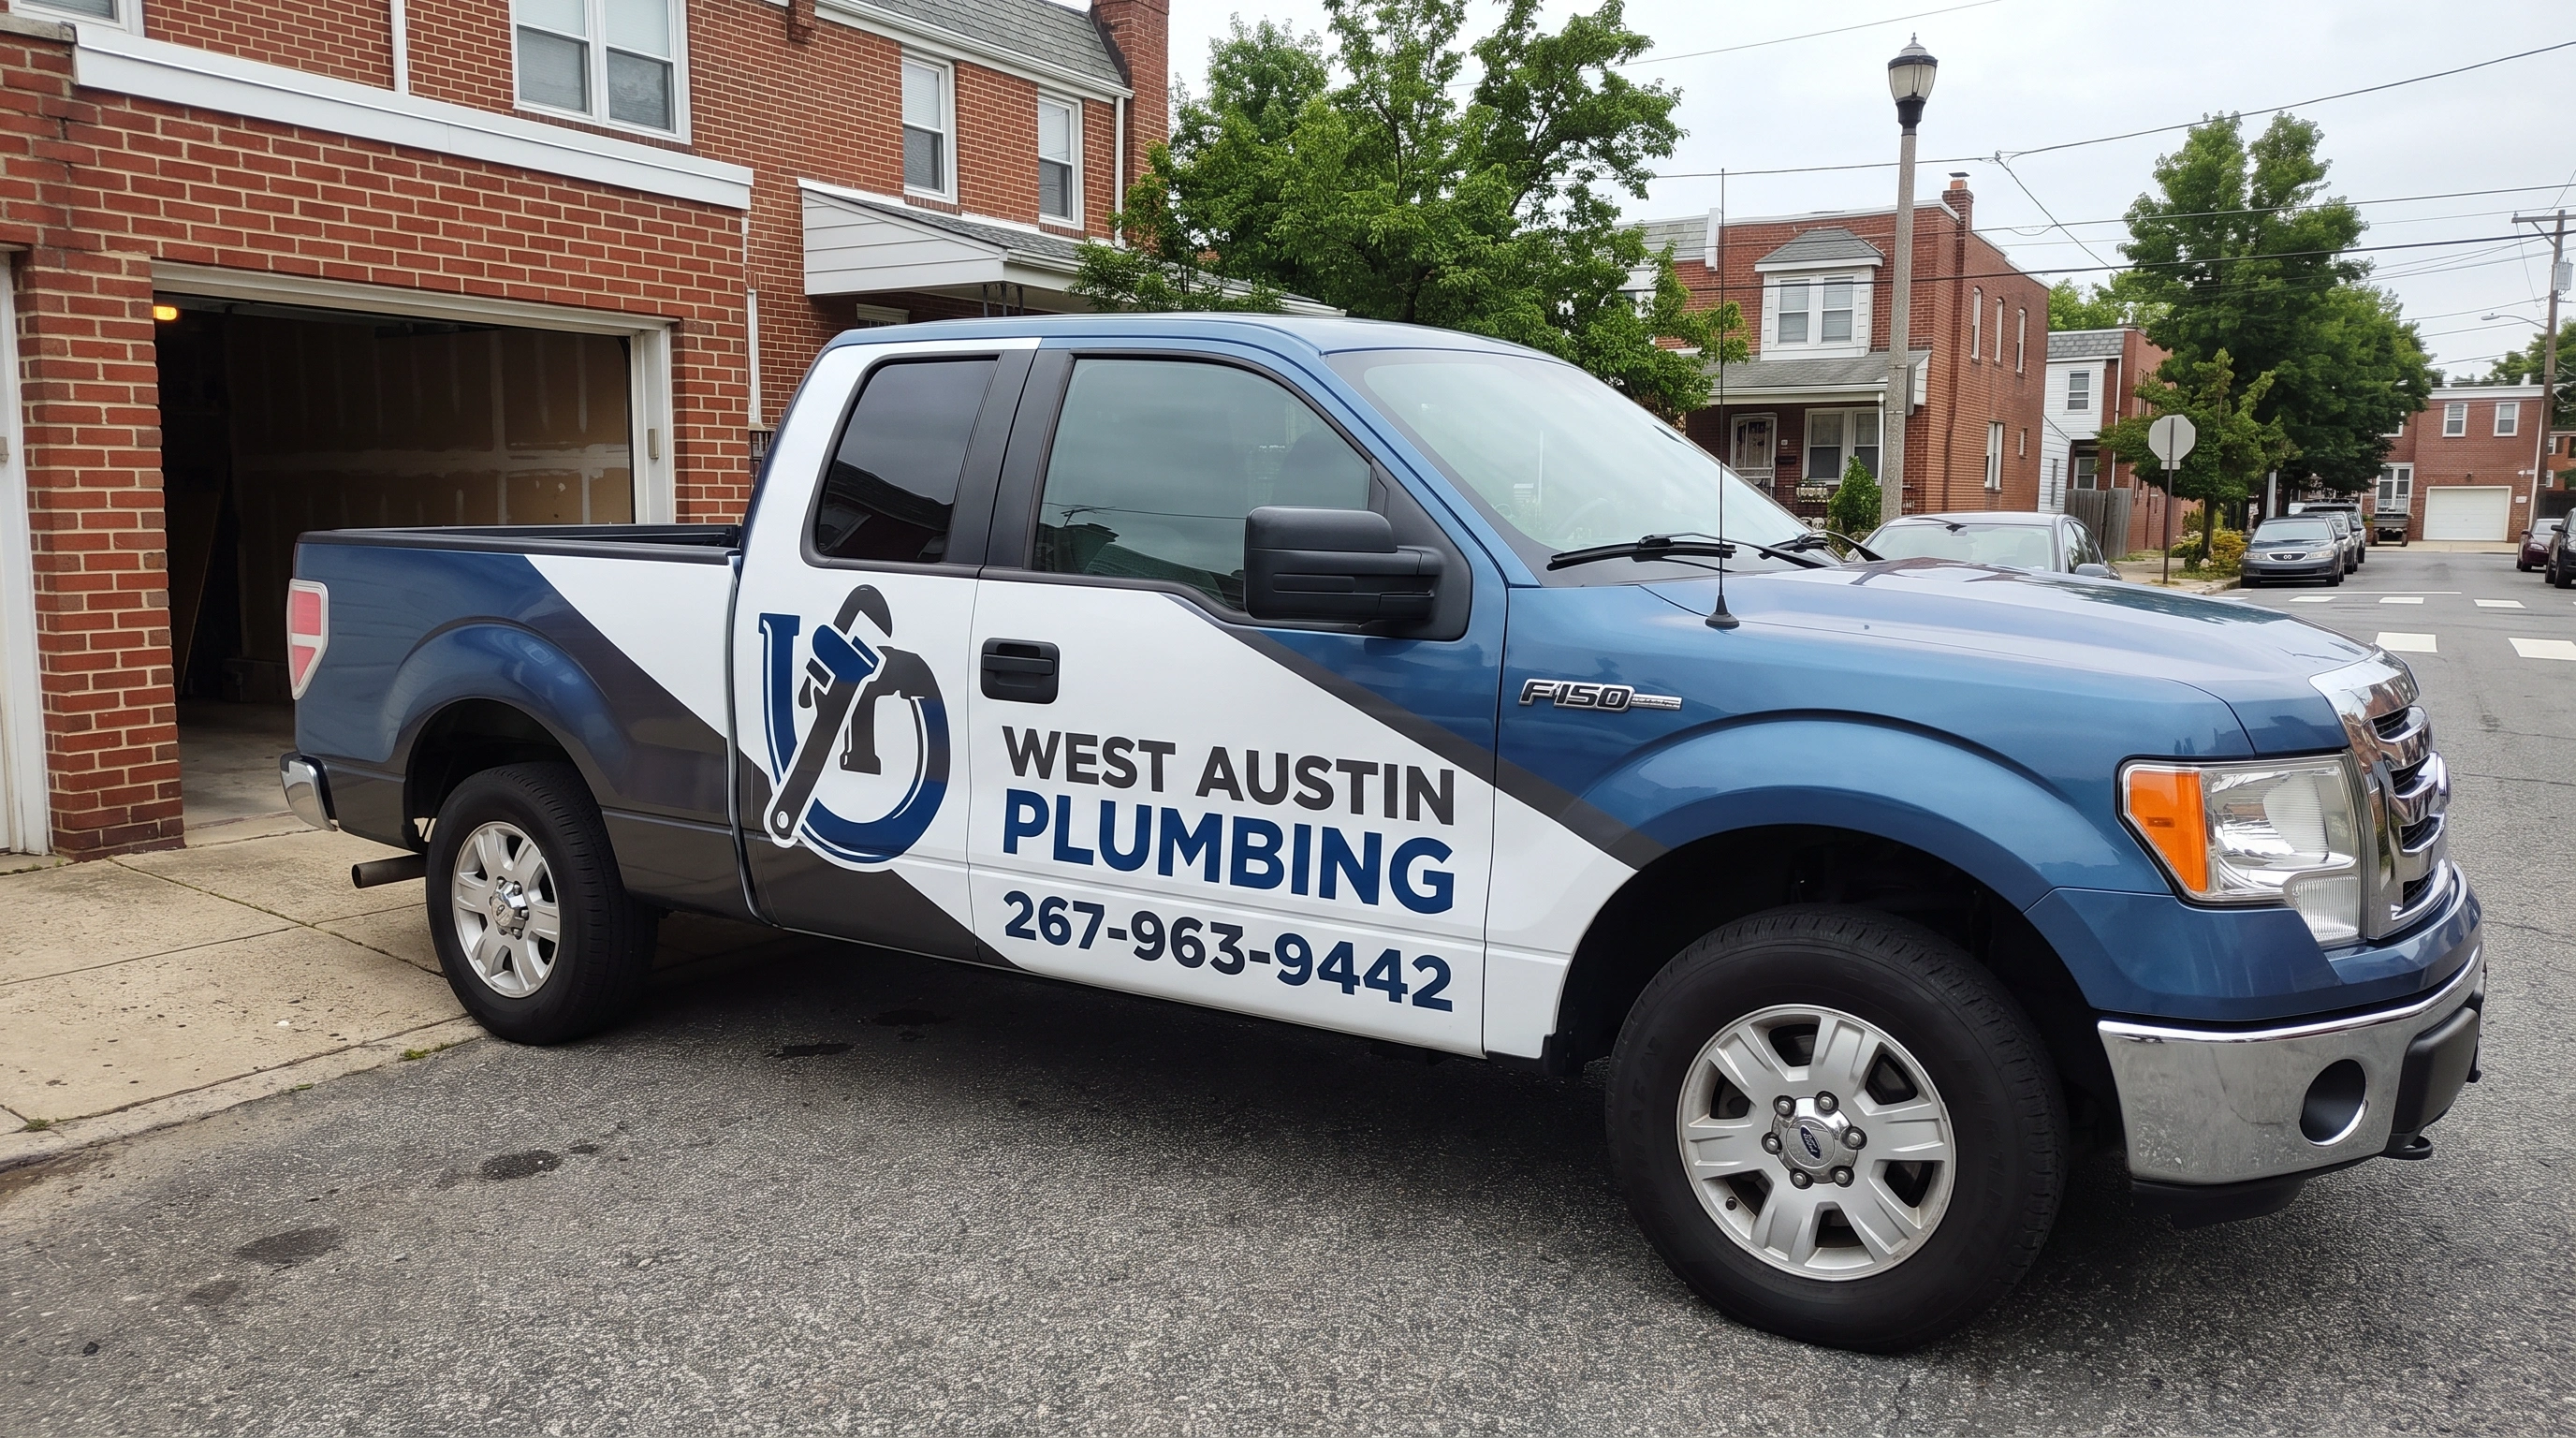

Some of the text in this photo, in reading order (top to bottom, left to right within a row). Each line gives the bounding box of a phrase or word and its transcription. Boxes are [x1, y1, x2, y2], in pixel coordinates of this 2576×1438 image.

[1002, 725, 1455, 827] WEST AUSTIN
[1003, 787, 1455, 915] PLUMBING
[1003, 890, 1453, 1013] 267-963-9442
